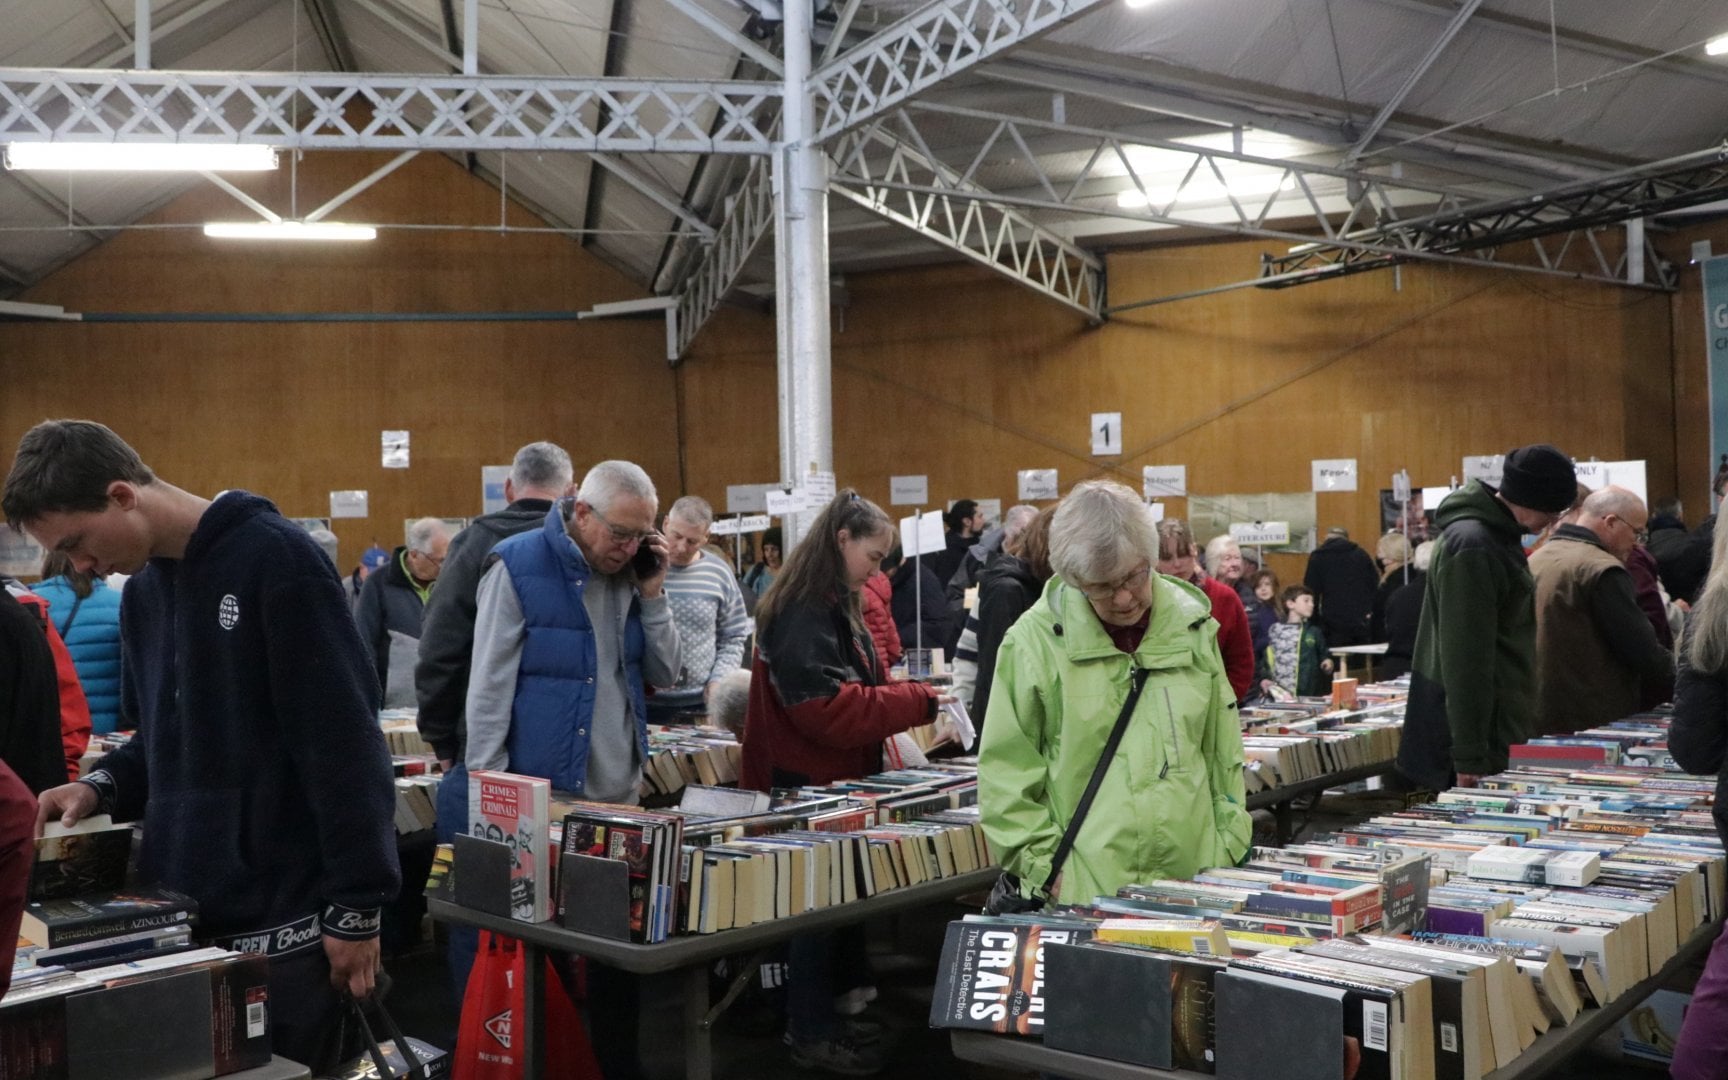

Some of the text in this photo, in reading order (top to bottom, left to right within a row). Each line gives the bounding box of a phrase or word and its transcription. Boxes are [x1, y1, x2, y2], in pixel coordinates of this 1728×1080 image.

[1100, 422, 1109, 447] 1
[1237, 533, 1286, 542] ITERATURE
[482, 784, 517, 797] CRIMES
[482, 801, 517, 817] CRIMINALS
[1392, 905, 1410, 918] CASE
[130, 913, 182, 929] AZINCOUR
[232, 934, 271, 953] CREW
[967, 929, 979, 947] The
[964, 949, 976, 972] Last
[954, 973, 972, 1020] Detective
[1011, 990, 1024, 1016] £12.99
